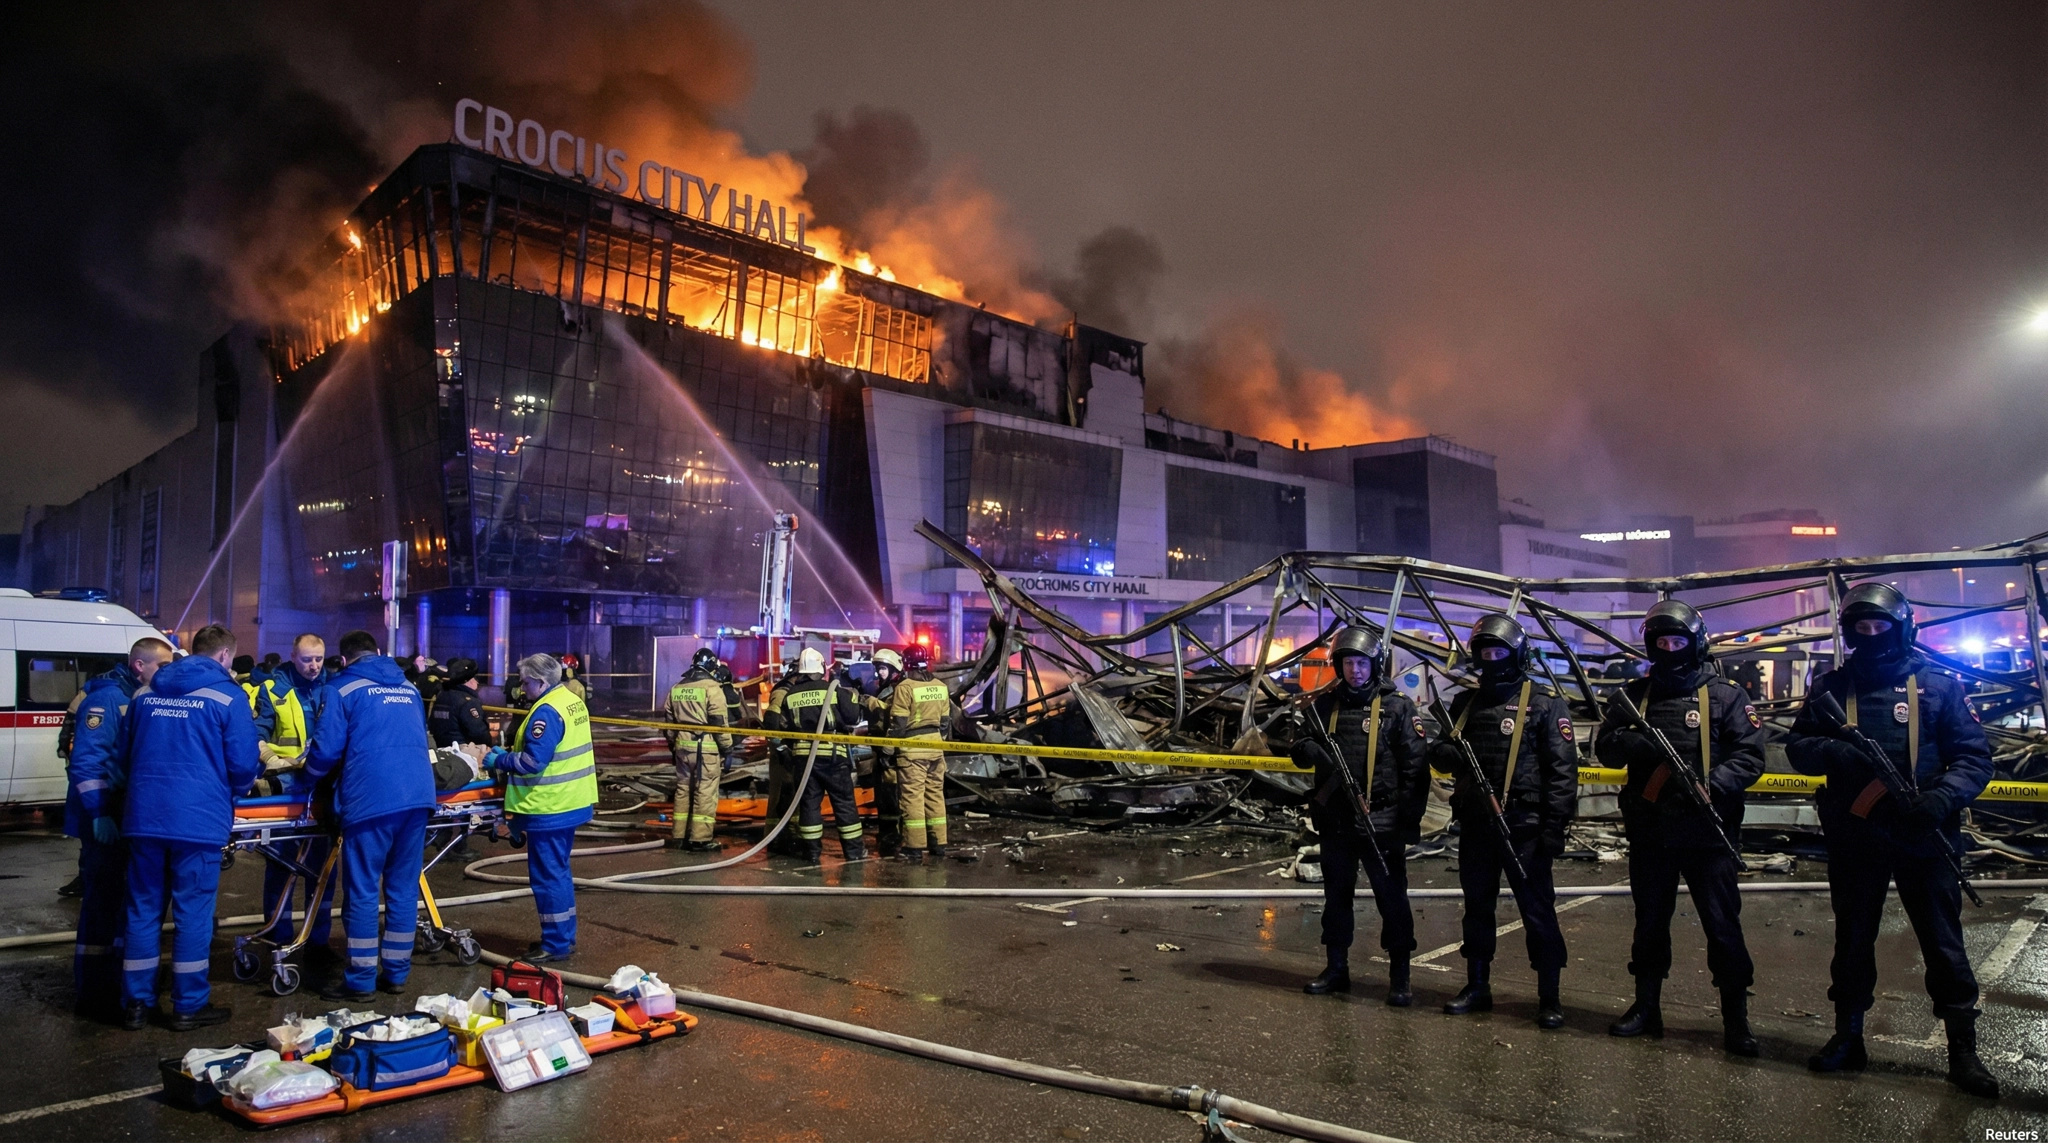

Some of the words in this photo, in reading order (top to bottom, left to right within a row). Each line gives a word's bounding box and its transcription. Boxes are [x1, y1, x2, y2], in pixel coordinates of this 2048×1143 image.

[455, 98, 629, 194] CROCUS
[639, 160, 721, 222] CITY
[728, 188, 817, 254] HALL
[1083, 580, 1110, 593] CITY
[1766, 778, 1808, 787] CAUTION
[1990, 786, 2039, 796] CAUTION
